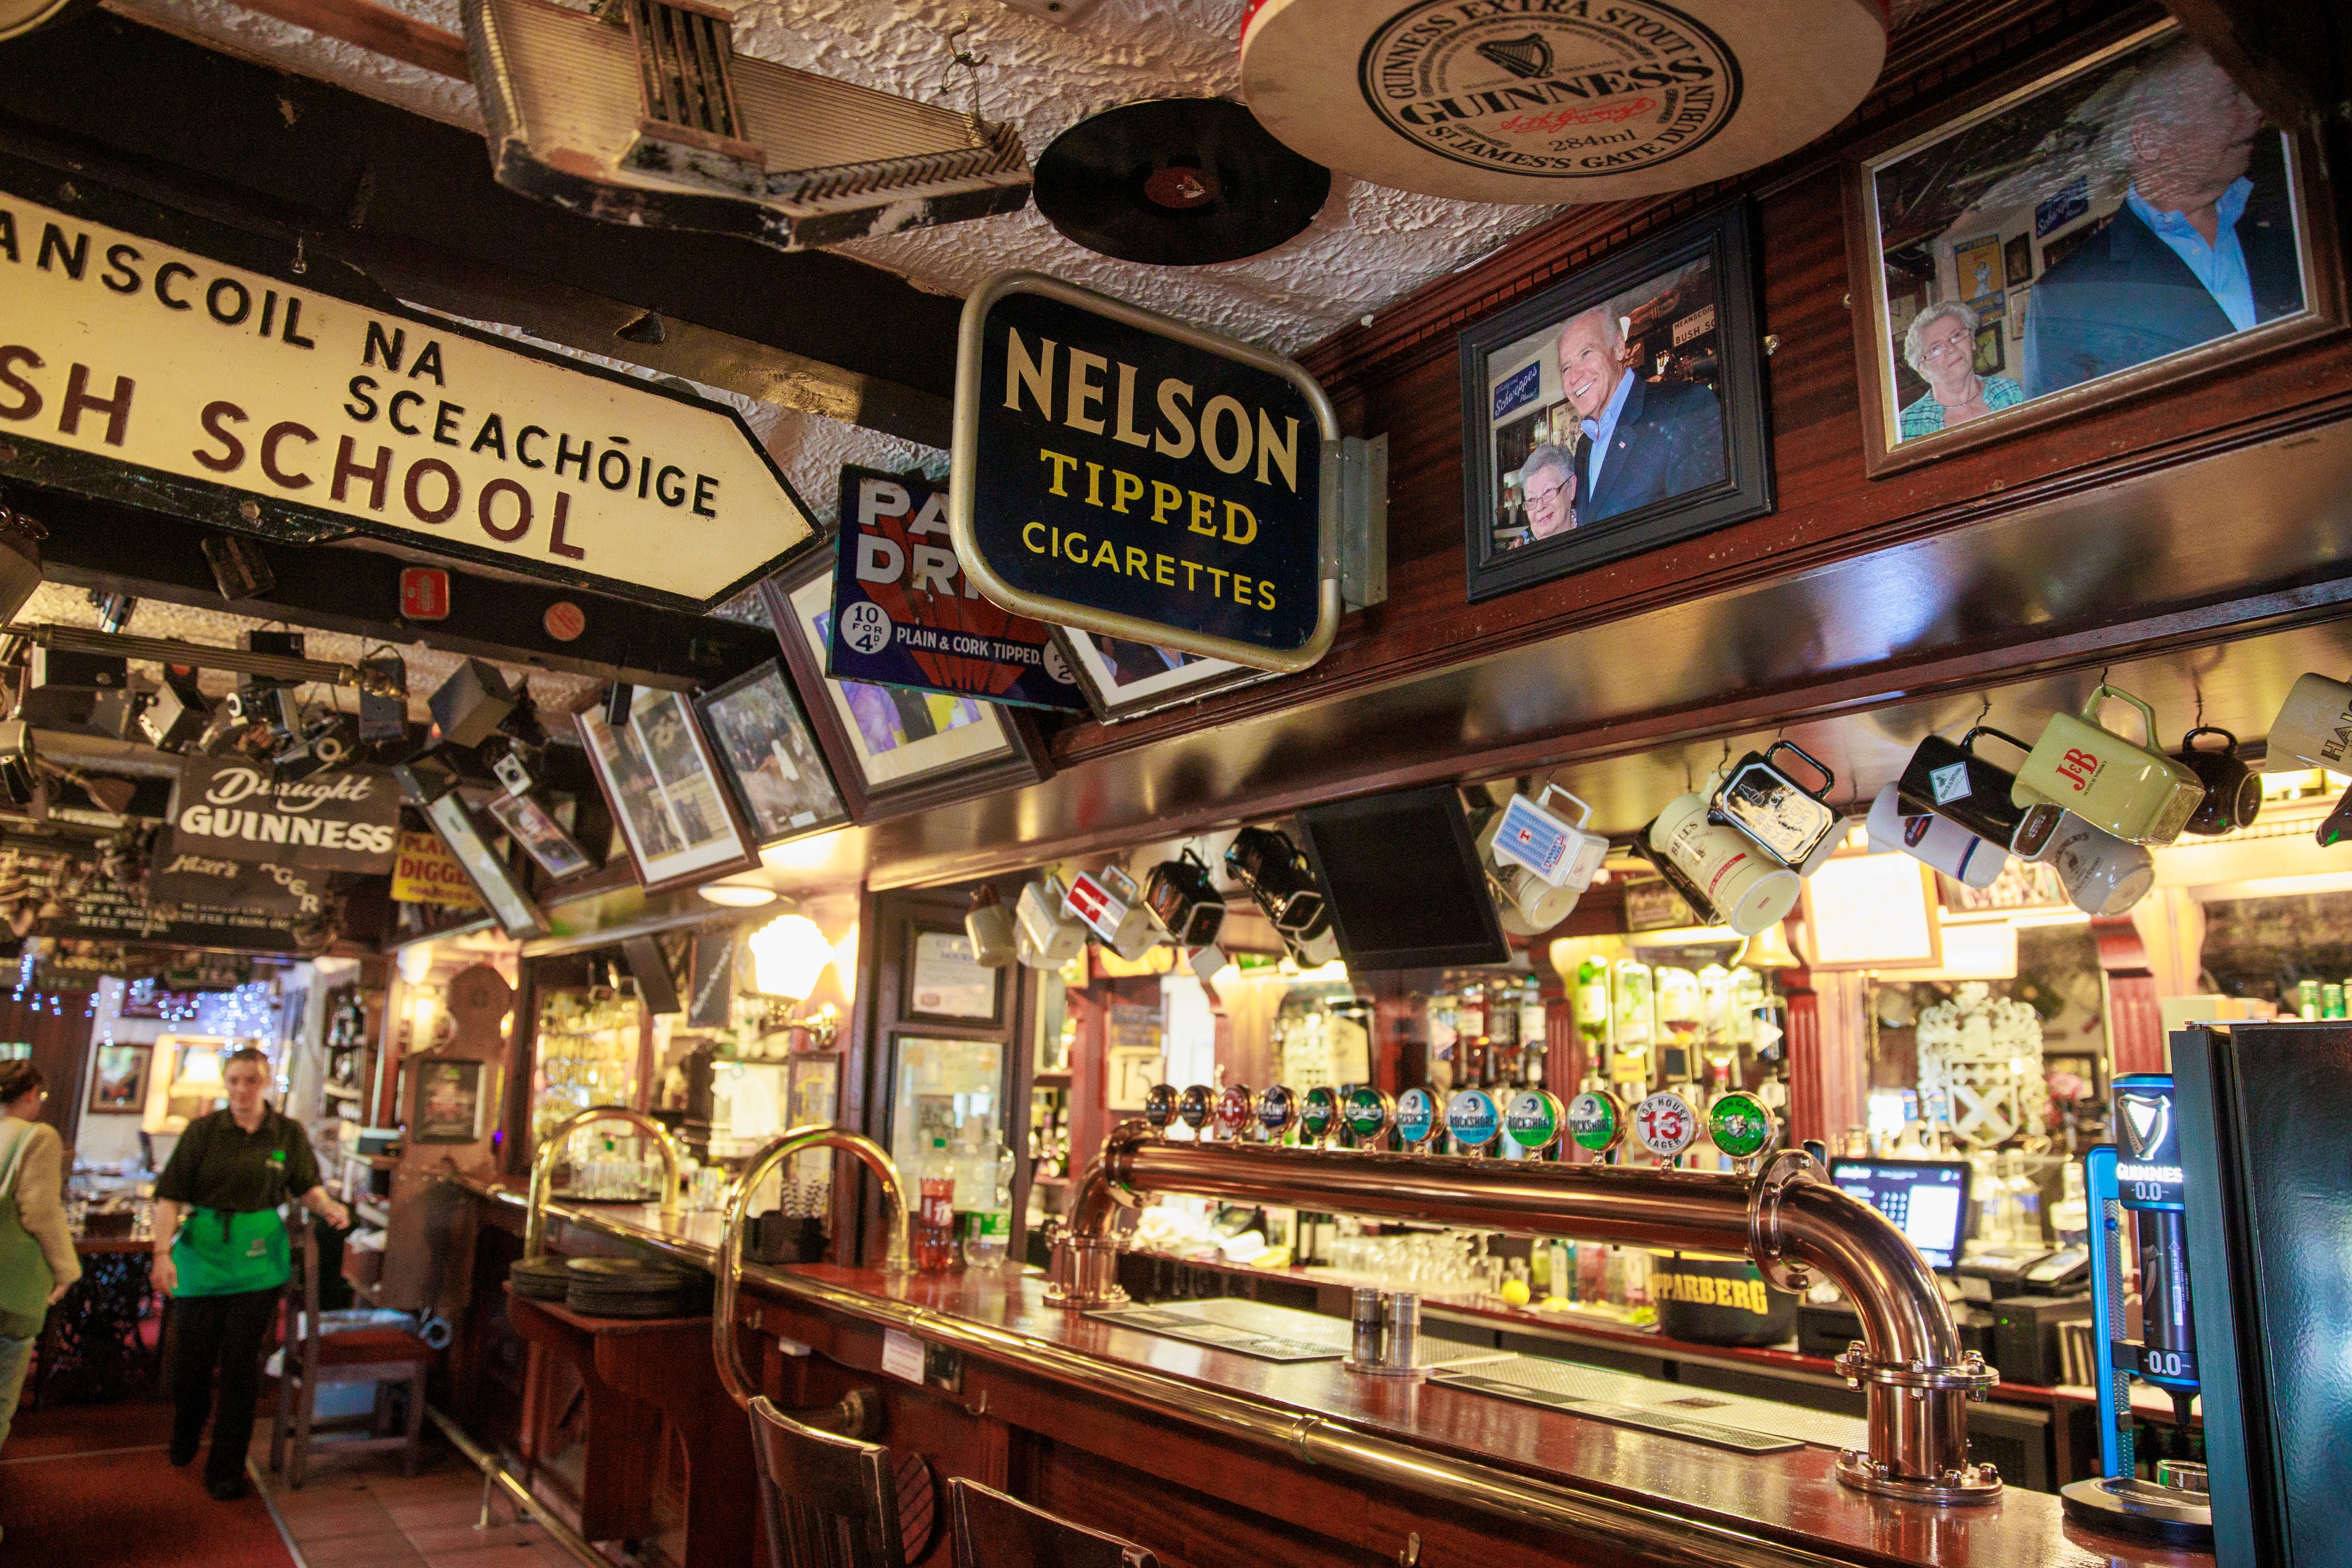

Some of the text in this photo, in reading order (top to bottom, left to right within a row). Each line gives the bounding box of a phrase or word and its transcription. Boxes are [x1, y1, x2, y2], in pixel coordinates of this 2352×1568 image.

[1383, 14, 1457, 99] GUINNESS
[1595, 7, 1696, 54] STOUT
[1400, 55, 1714, 125] GUINNESS
[1449, 137, 1571, 169] JAMES'S
[1579, 143, 1666, 168] GATE
[1659, 84, 1715, 147] DUBLIN
[1549, 129, 1639, 152] 284ml
[1676, 326, 1700, 345] BUSH
[361, 321, 445, 387] NA
[1002, 326, 1300, 493] NELSON
[191, 400, 585, 560] SCHOOL
[1040, 448, 1258, 546] TIPPED
[1022, 521, 1276, 611] CIGARETTES
[852, 622, 882, 634] FOR
[855, 605, 879, 623] 10
[896, 626, 1042, 665] PLAIN & CORK TIPPED.
[2321, 699, 2352, 762] HAI
[2055, 747, 2097, 791] J&B
[2083, 778, 2096, 795] SCOTCH
[1754, 790, 1784, 824] BLACK
[1770, 800, 1805, 841] SCOTCH
[179, 805, 395, 854] GUINNESS
[1671, 821, 1699, 856] BELL'S
[1780, 810, 1813, 845] WHISKY
[1450, 1114, 1494, 1128] ROCKSHORE
[1508, 1115, 1552, 1130] ROCKSHORE
[1639, 1098, 1689, 1123] HOP HOUSE
[1644, 1111, 1682, 1139] 13
[1736, 1100, 1759, 1121] GATE
[1647, 1137, 1681, 1149] LAGER
[2135, 1181, 2162, 1201] 0.0
[2149, 1351, 2182, 1376] 0.0
